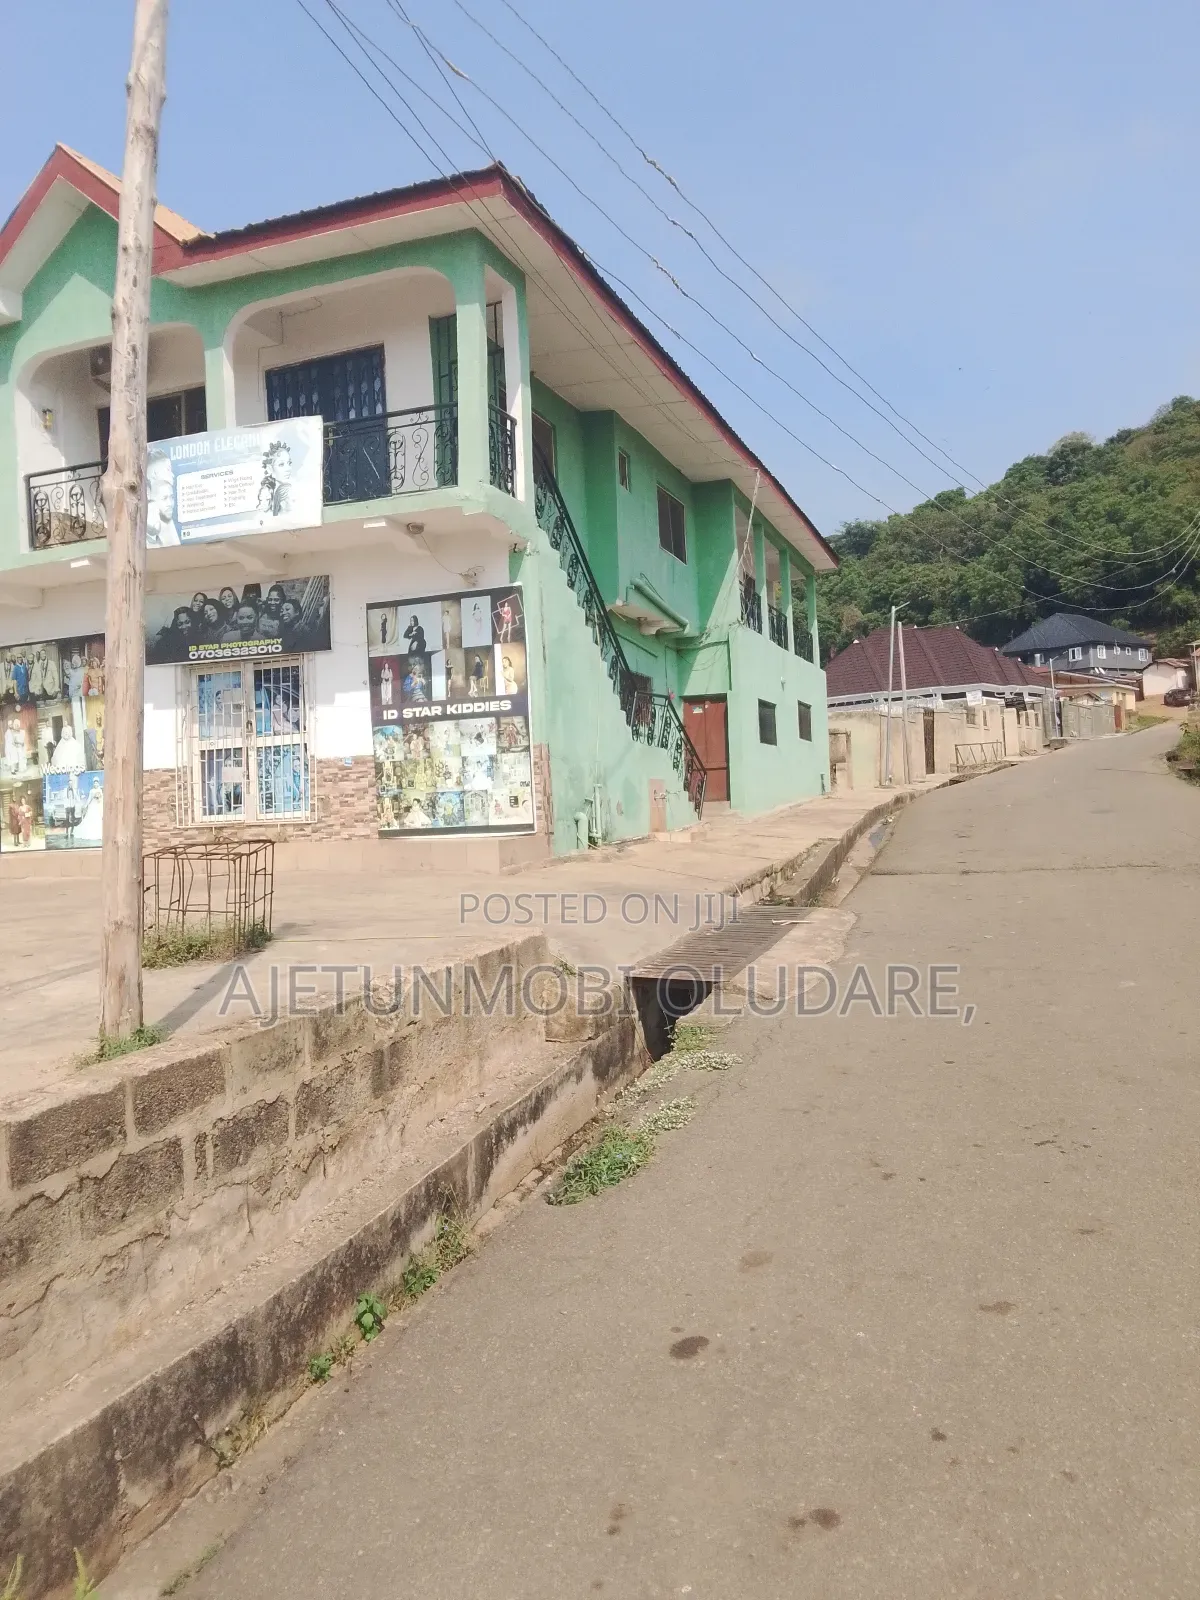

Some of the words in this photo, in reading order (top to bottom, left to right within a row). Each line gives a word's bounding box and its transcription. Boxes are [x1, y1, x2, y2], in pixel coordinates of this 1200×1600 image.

[170, 440, 211, 461] LONDON
[201, 469, 234, 480] SERVICES
[189, 644, 283, 660] 07036323010
[199, 643, 219, 651] STAR
[220, 638, 283, 649] PHOTOGRAPHY
[383, 709, 398, 720] ID
[402, 705, 442, 719] STAR
[446, 700, 512, 715] KIDDIES
[41, 762, 86, 776] Weddings
